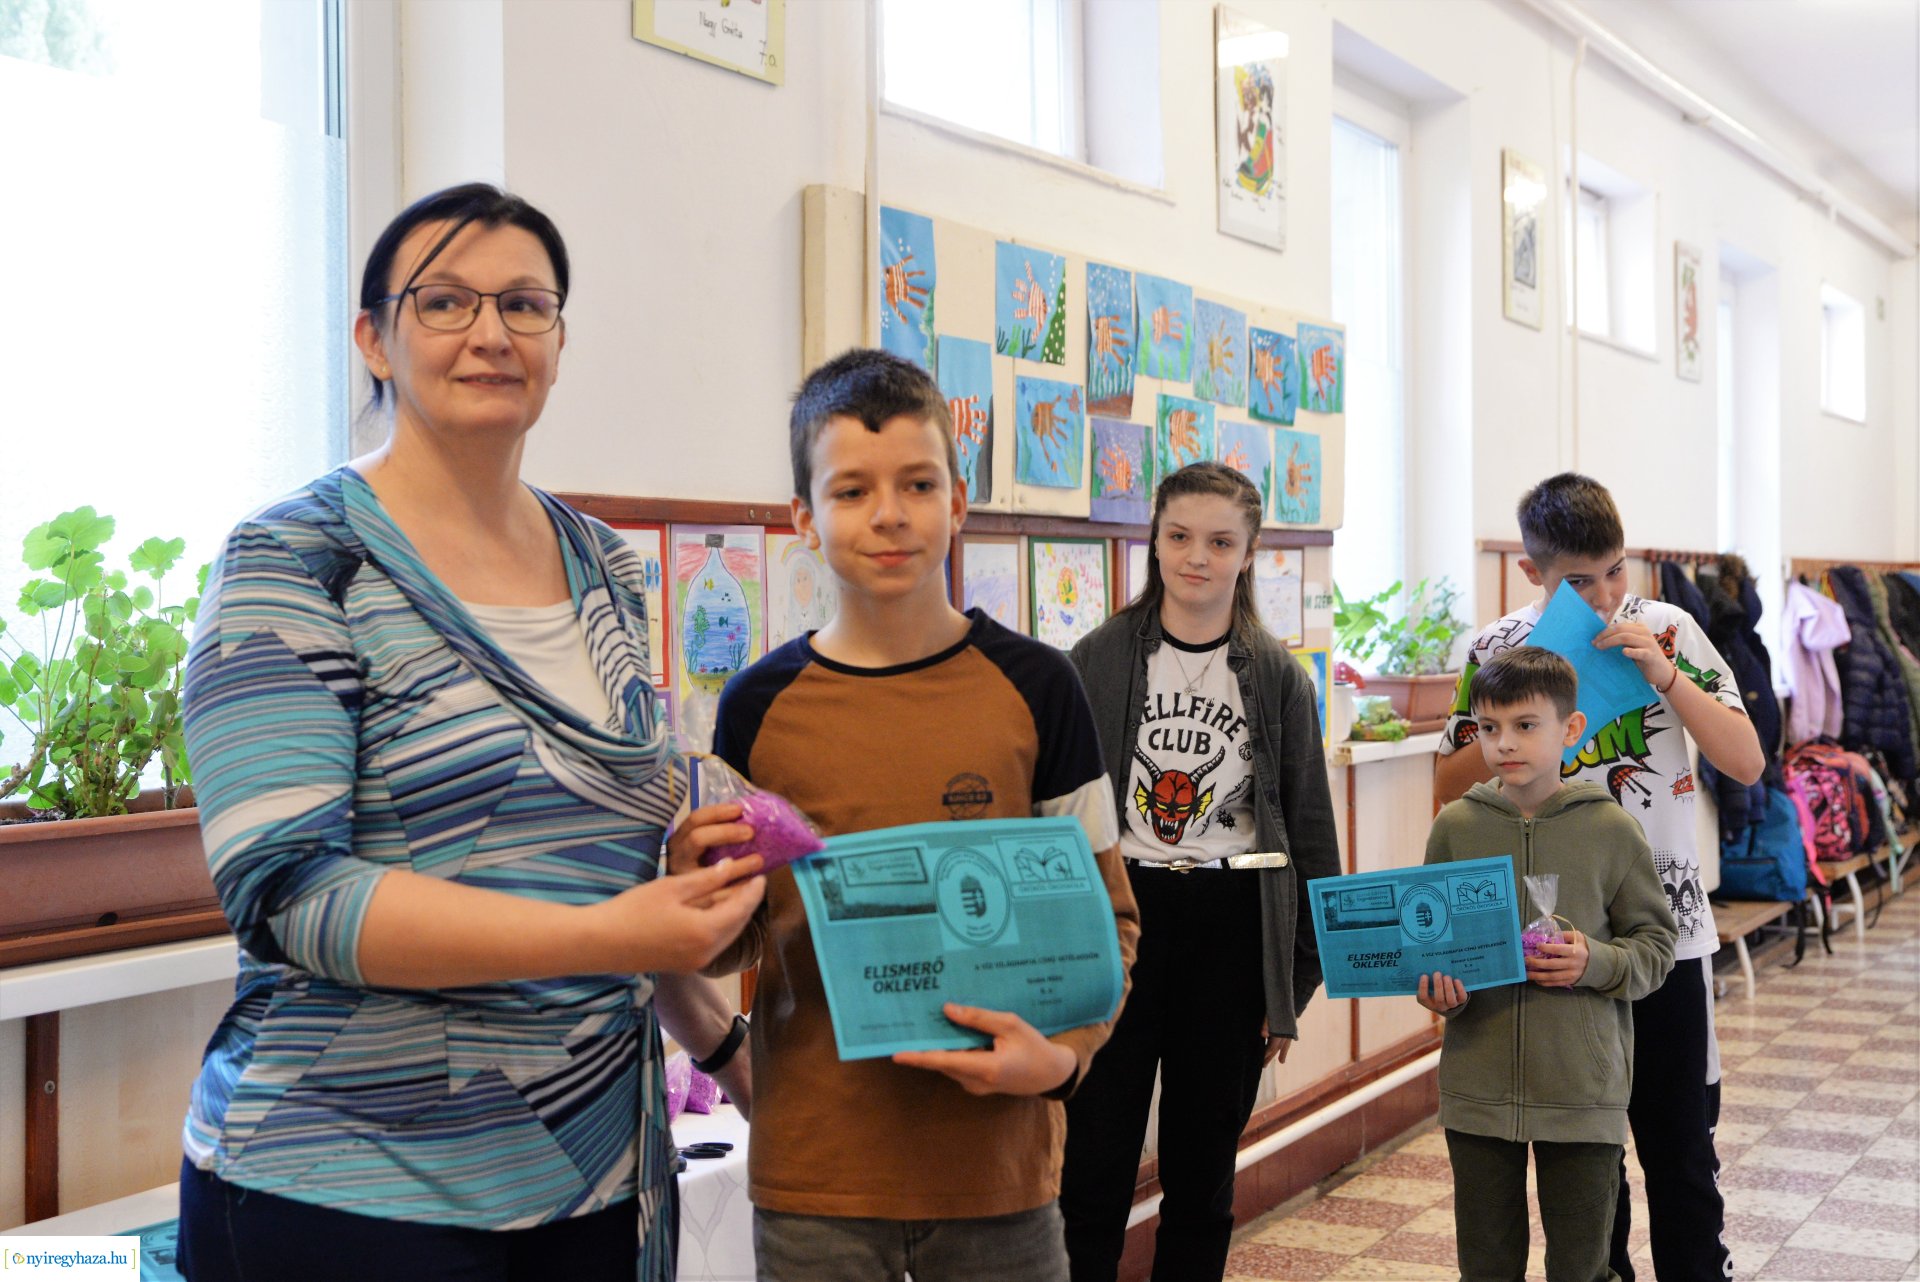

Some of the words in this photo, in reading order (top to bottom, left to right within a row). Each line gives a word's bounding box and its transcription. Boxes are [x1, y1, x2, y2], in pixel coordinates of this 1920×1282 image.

[1148, 727, 1212, 755] CLUB
[864, 955, 945, 980] ELISMERŐ
[1347, 949, 1402, 961] ELISMERŐ
